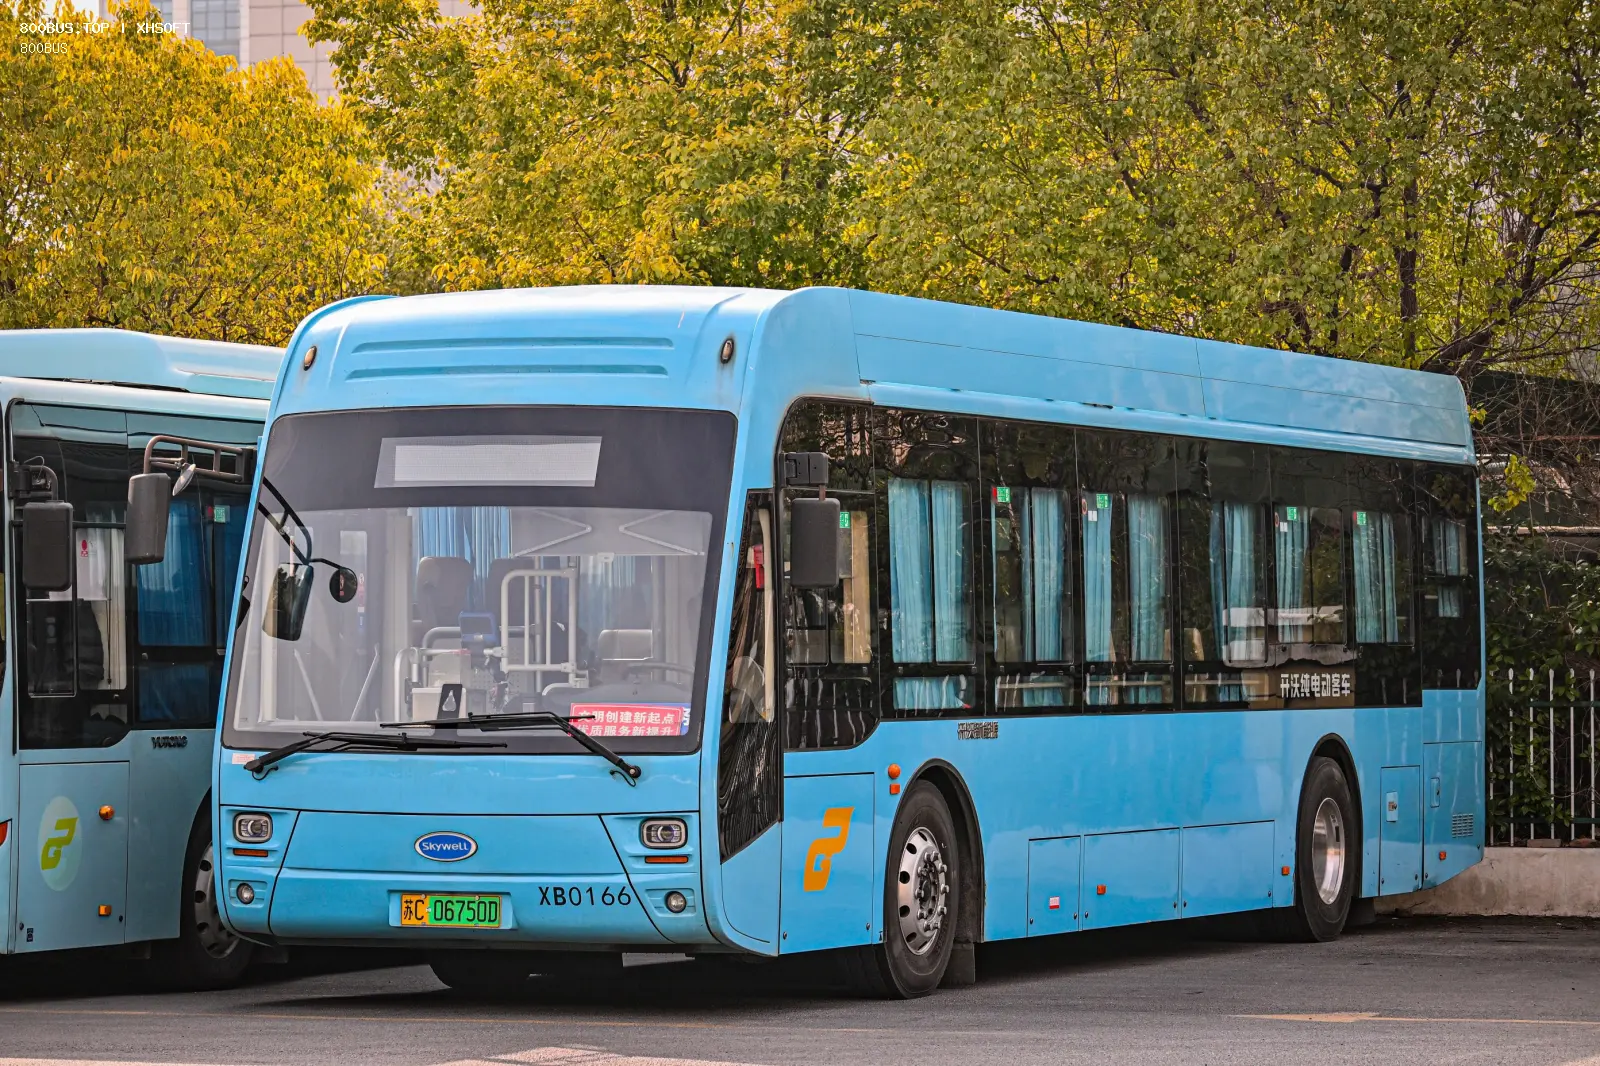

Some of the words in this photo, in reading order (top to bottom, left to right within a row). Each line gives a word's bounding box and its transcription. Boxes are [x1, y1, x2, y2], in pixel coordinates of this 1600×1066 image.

[1280, 673, 1351, 698] 开沃纯电动客车
[577, 710, 675, 724] 文明创建新起点
[422, 842, 469, 851] Skywell
[538, 886, 632, 907] XB0166
[433, 900, 498, 923] 06750D
